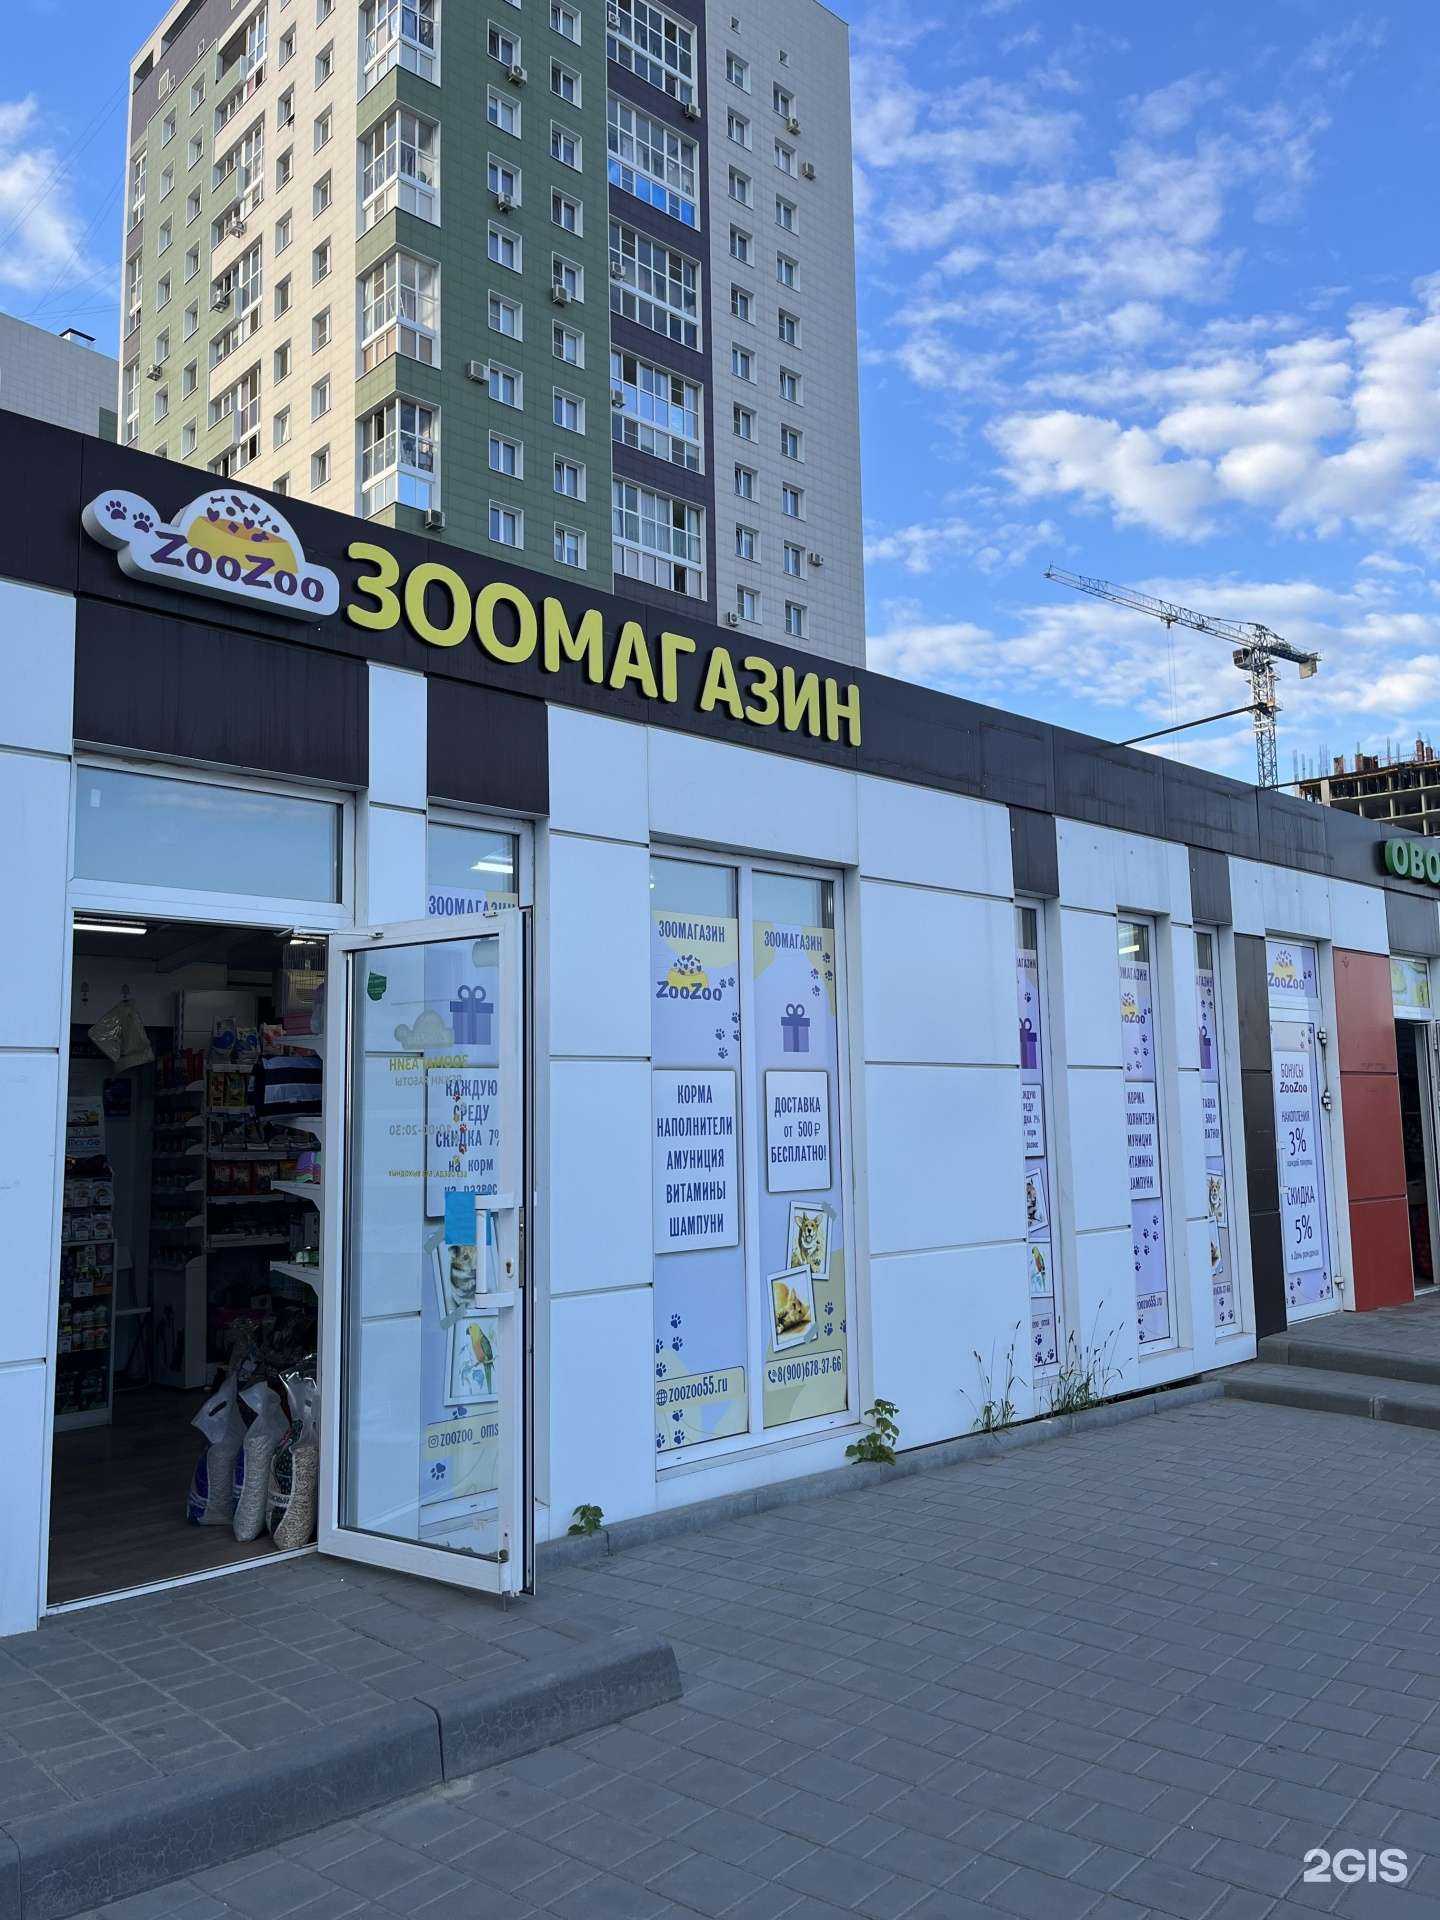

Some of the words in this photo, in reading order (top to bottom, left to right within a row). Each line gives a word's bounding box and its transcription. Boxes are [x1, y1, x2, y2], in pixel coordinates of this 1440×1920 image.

[151, 530, 325, 603] ZooZoo
[347, 541, 862, 747] ЗООМАГАЗИН
[658, 920, 725, 943] ЗООМАГАЗИН
[764, 930, 823, 951] ЗООМАГАЗИН
[656, 980, 723, 1001] ZooZoo
[1268, 973, 1305, 990] ZooZoo
[445, 1080, 498, 1099] КАЖДУЮ
[677, 1085, 713, 1104] КОРМА
[1127, 1092, 1145, 1104] КОРМА
[1280, 1082, 1307, 1094] ZooZoo
[453, 1104, 490, 1125] СРЕДУ
[774, 1097, 821, 1117] ДОСТАВКА
[656, 1116, 733, 1137] НАПОЛНИТЕЛИ
[784, 1125, 793, 1138] от
[435, 1129, 483, 1149] СКИДКА
[1289, 1128, 1307, 1156] 3%
[667, 1149, 725, 1172] АМУНИЦИЯ
[771, 1145, 827, 1163] БЕСПЛАТНО!
[468, 1158, 494, 1176] корм
[666, 1181, 726, 1204] ВИТАМИНЫ
[1287, 1185, 1316, 1208] СКИДКА
[669, 1213, 724, 1237] ШАМПУНИ
[1295, 1214, 1312, 1244] 5%
[777, 1355, 842, 1385] 8(900)678-37-66
[668, 1375, 728, 1403] zoozoo55.ru
